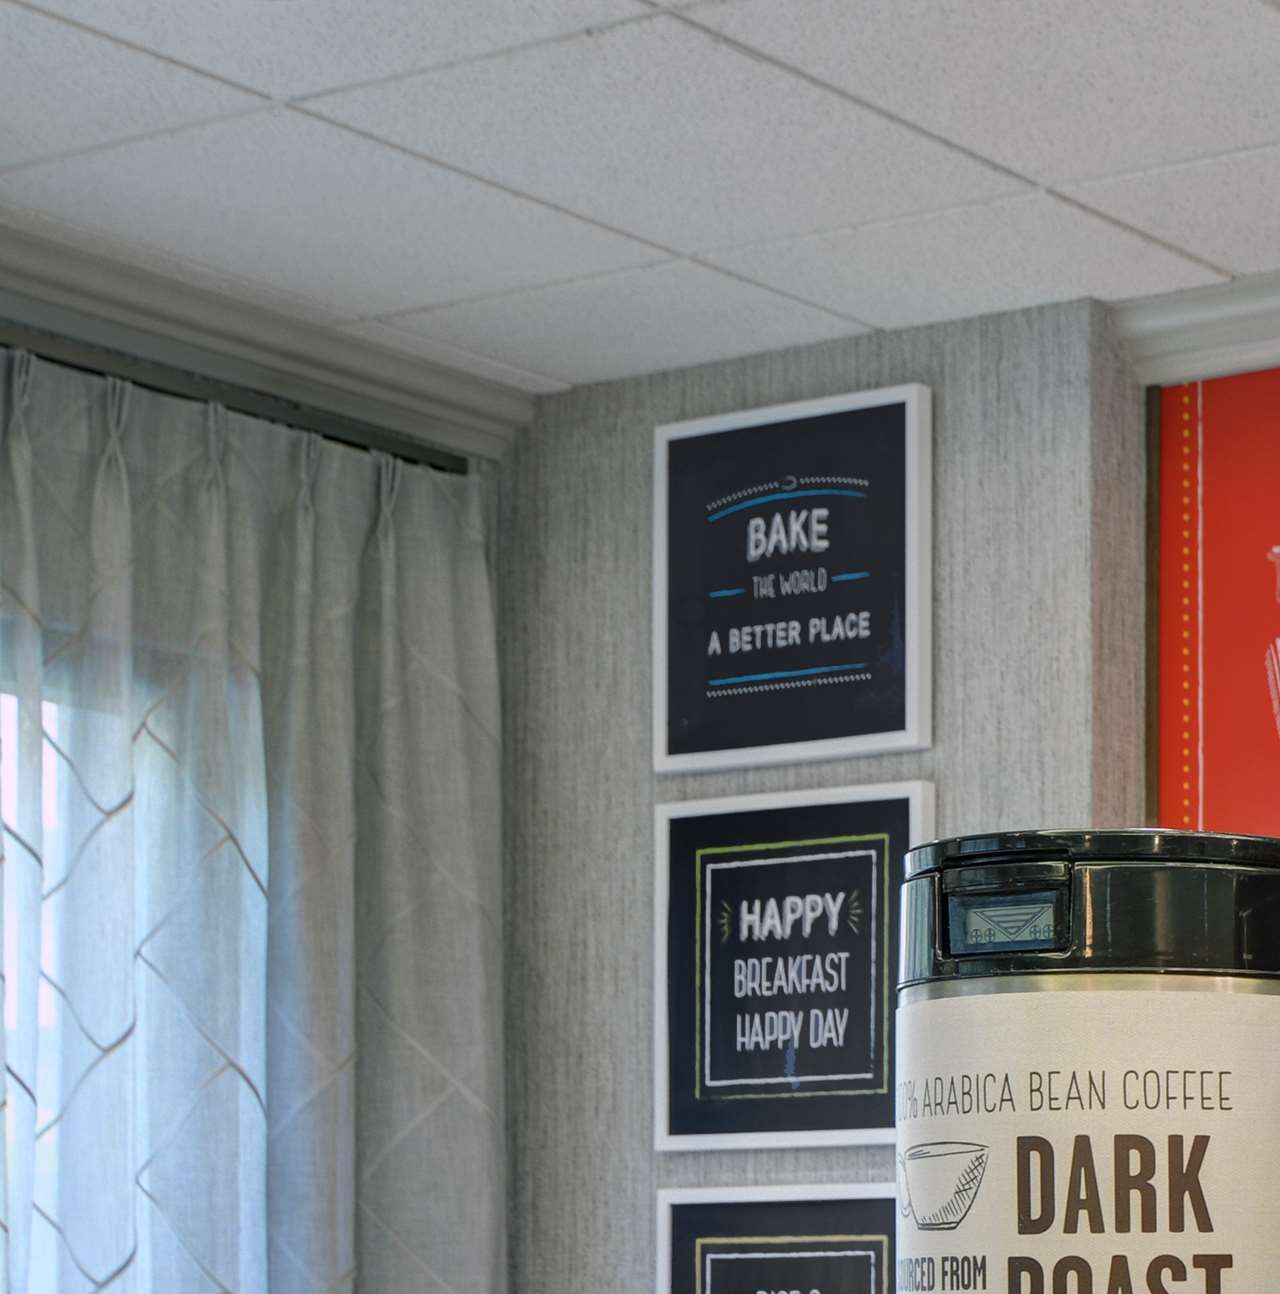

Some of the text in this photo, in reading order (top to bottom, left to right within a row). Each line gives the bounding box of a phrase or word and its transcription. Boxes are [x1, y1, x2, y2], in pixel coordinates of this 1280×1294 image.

[746, 508, 830, 562] BAKE
[752, 567, 827, 599] THE WORLD
[708, 611, 871, 656] A BETTER PLACE
[739, 891, 845, 942] HAPPY
[734, 952, 850, 998] BREAKFAST
[736, 1008, 848, 1052] HAPPY DAY
[922, 1073, 1016, 1117] ARABICA
[1030, 1070, 1106, 1111] BEAN
[1124, 1070, 1233, 1110] COFFEE
[1016, 1134, 1214, 1235] DARK
[941, 1255, 987, 1291] FROM
